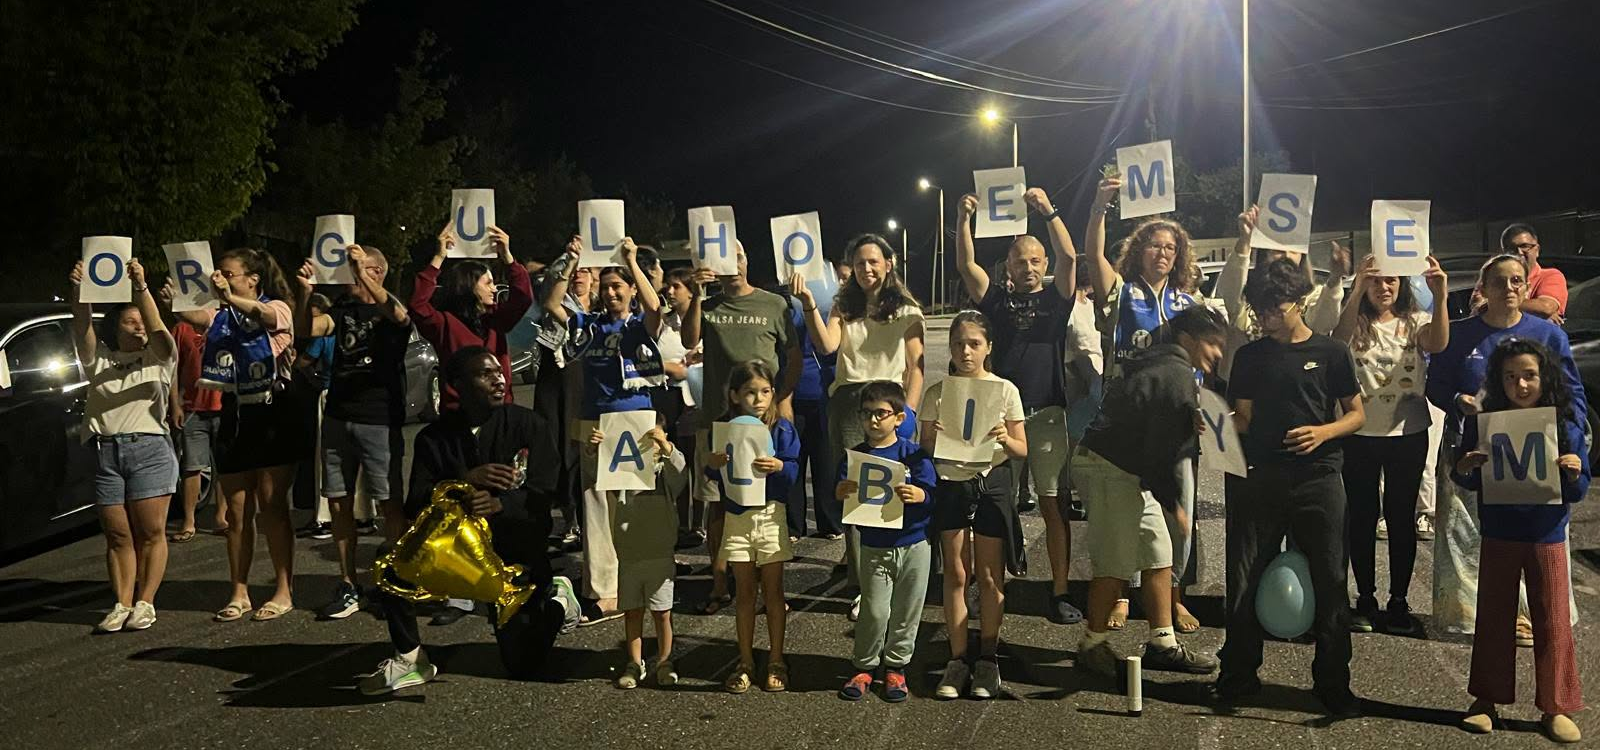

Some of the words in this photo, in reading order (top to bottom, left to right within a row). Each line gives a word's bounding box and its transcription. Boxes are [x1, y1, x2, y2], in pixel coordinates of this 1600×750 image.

[1127, 160, 1166, 201] M
[988, 185, 1018, 221] E
[1268, 192, 1300, 232] S
[456, 205, 485, 242] U
[590, 217, 616, 252] L
[697, 224, 727, 260] H
[1386, 219, 1418, 258] E
[316, 232, 347, 268] G
[783, 231, 815, 266] O
[89, 252, 124, 287] O
[177, 260, 209, 294] R
[704, 314, 733, 325] SALSA
[737, 315, 768, 326] JEANS
[963, 398, 975, 441] I
[1201, 408, 1225, 452] Y
[608, 431, 644, 472] A
[726, 443, 753, 485] L
[1491, 432, 1548, 482] M
[858, 462, 893, 506] B
